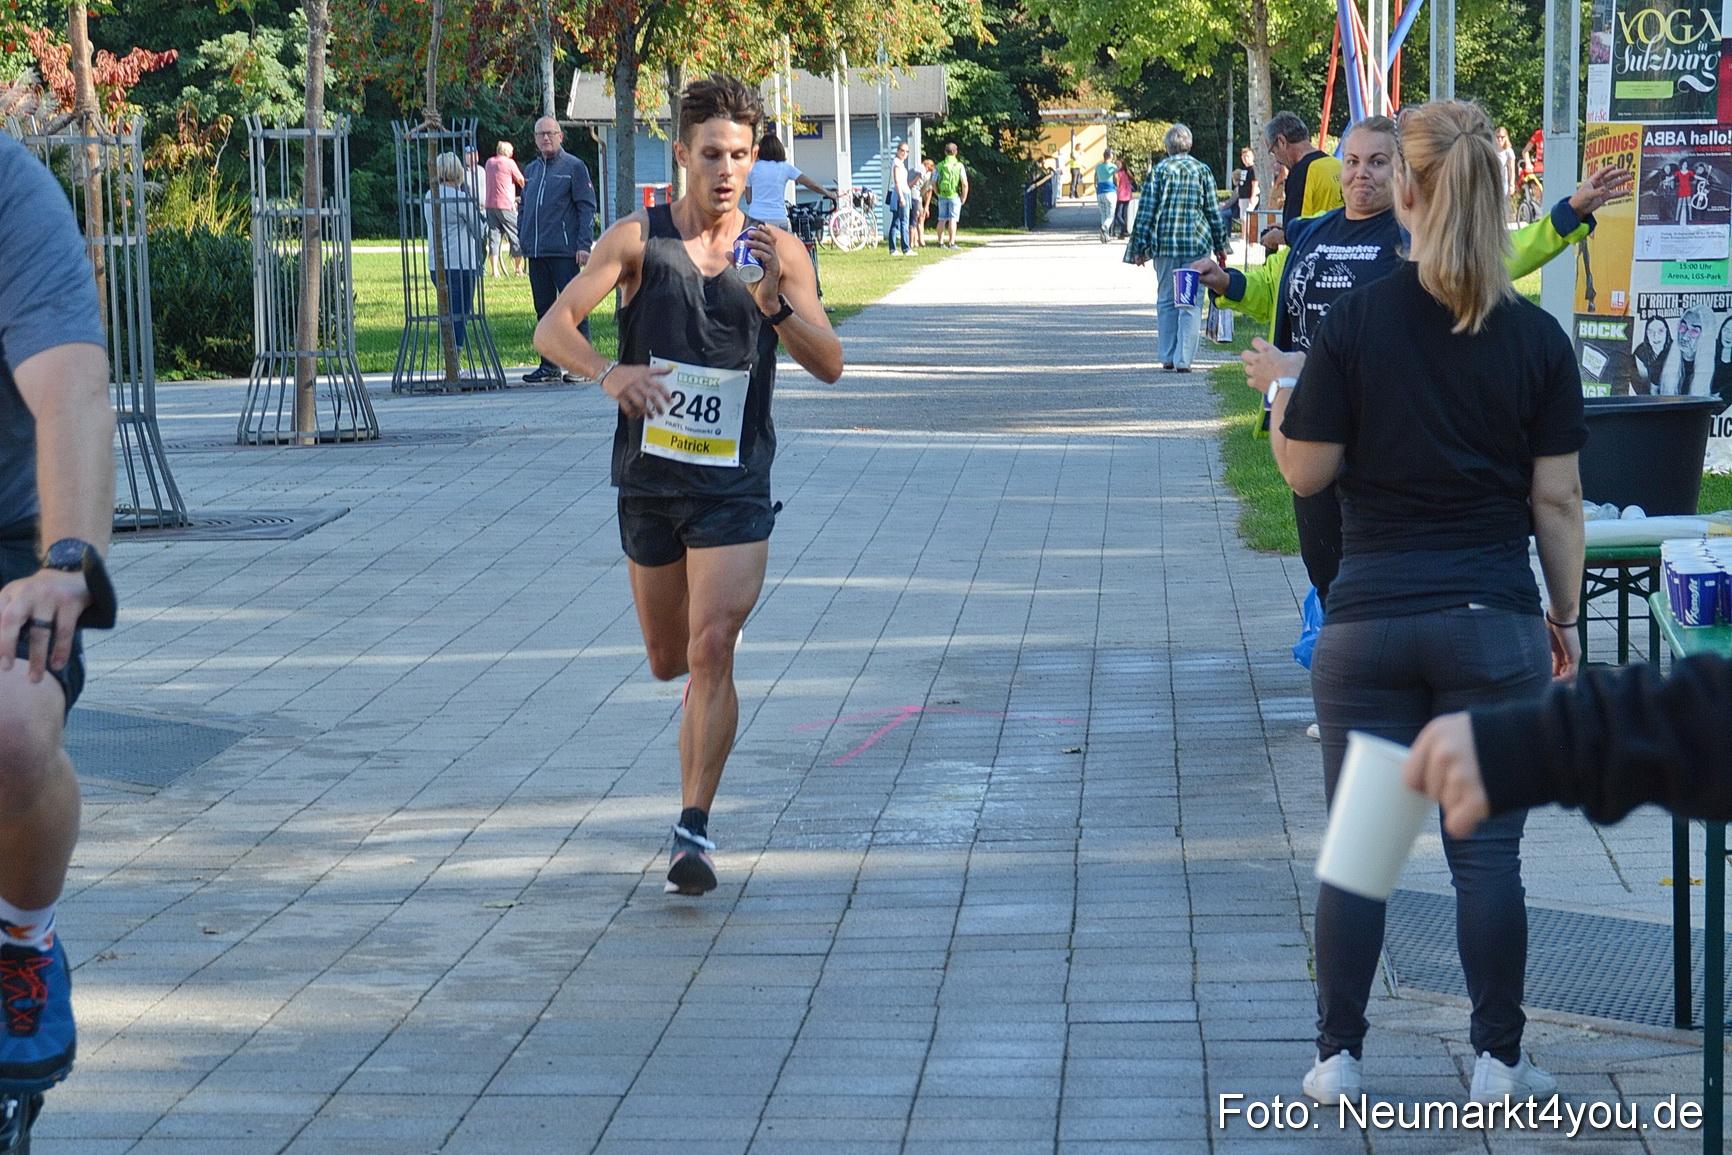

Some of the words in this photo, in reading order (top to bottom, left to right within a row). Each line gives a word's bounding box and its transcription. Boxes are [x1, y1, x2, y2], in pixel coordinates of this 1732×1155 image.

[1617, 8, 1722, 45] YOGA
[1697, 41, 1708, 52] in
[1614, 34, 1722, 93] Sulzbürg
[1644, 131, 1687, 146] ABBA
[1690, 130, 1732, 146] hallo!
[1314, 244, 1381, 254] Neumarkter
[1325, 253, 1378, 261] STADTLAUF
[1579, 321, 1627, 340] BOCK
[669, 390, 722, 424] 248
[684, 425, 713, 435] Neumarkt
[670, 435, 710, 453] Patrick
